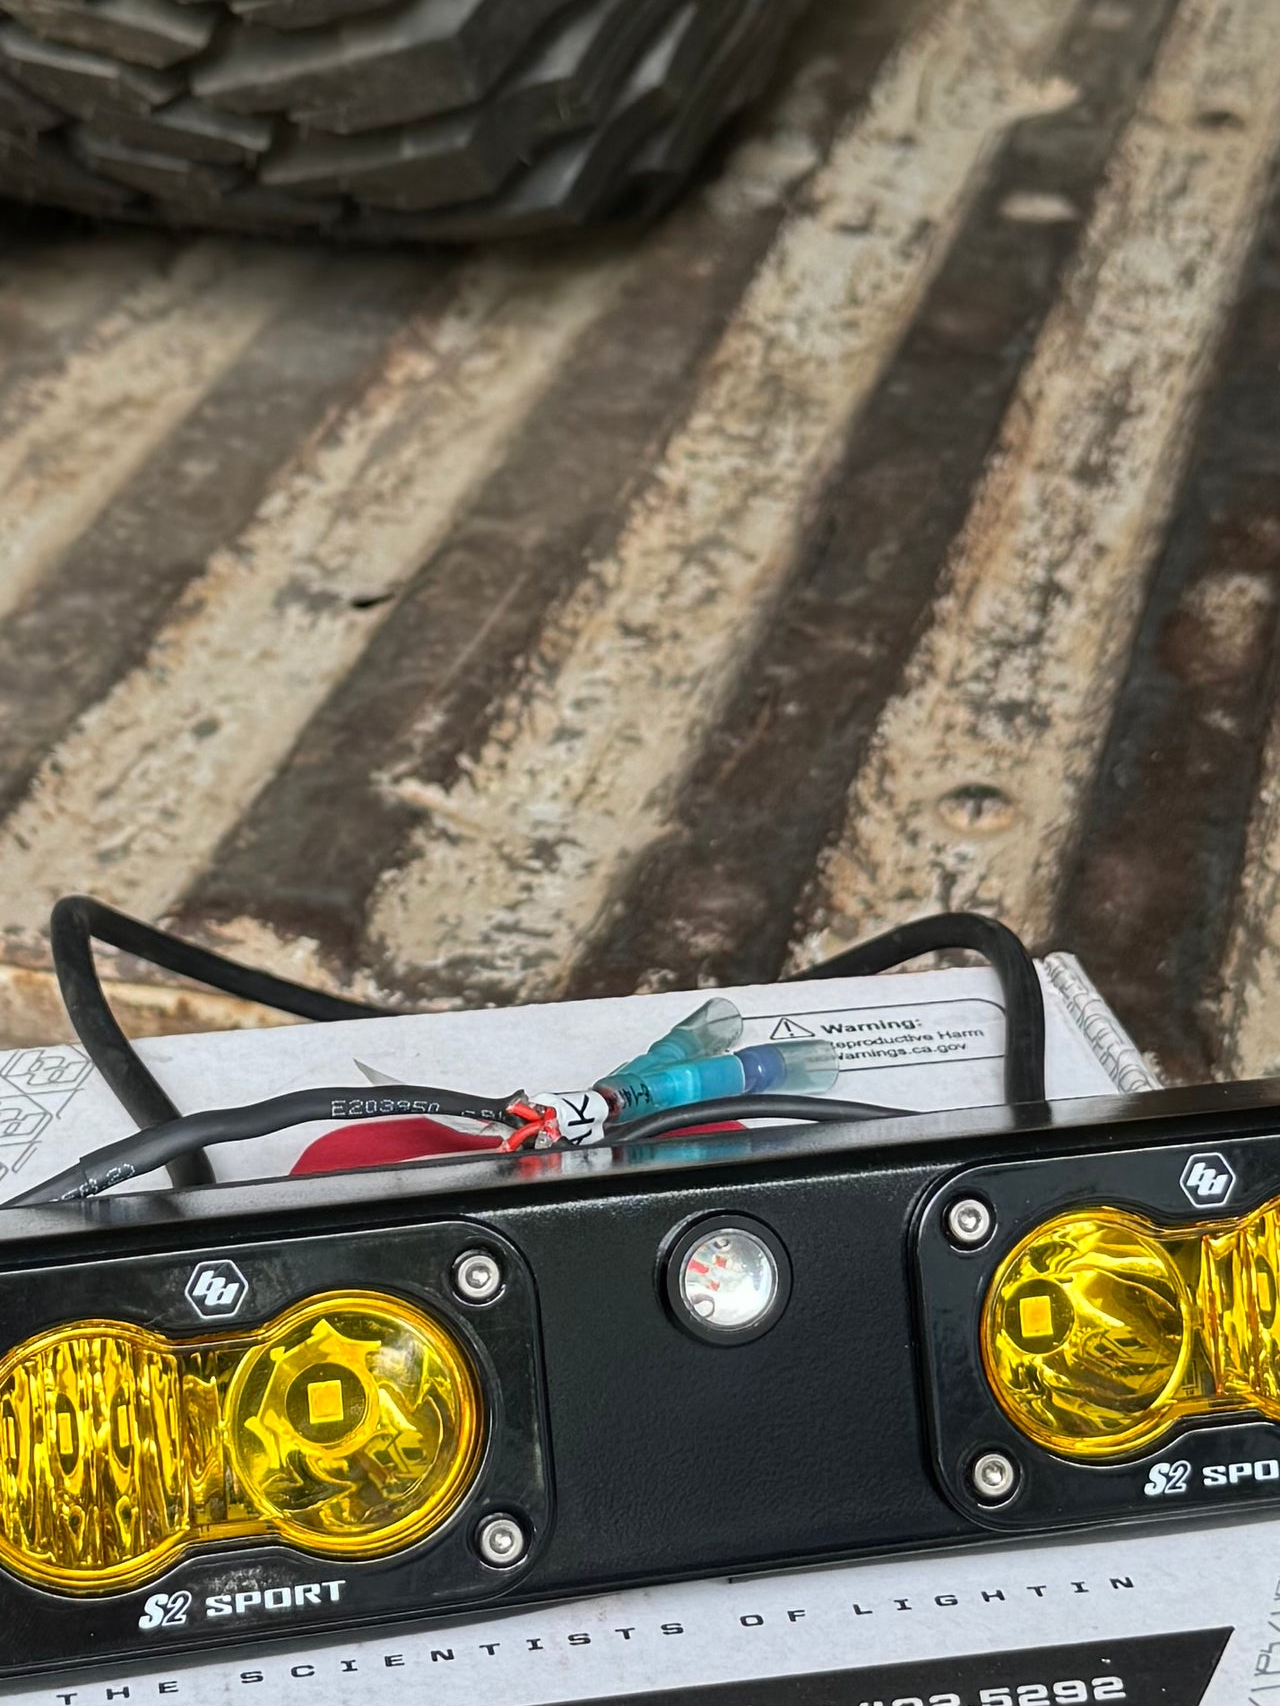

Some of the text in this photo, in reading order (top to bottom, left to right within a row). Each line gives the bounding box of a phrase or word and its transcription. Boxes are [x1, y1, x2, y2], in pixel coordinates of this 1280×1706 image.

[820, 1018, 923, 1034] Warning:
[937, 1028, 984, 1041] Harm
[1144, 1460, 1192, 1496] S2
[138, 1579, 346, 1630] S2 SPORT
[56, 1576, 1135, 1706] THE SCIENTISTS OF LIGHTIN
